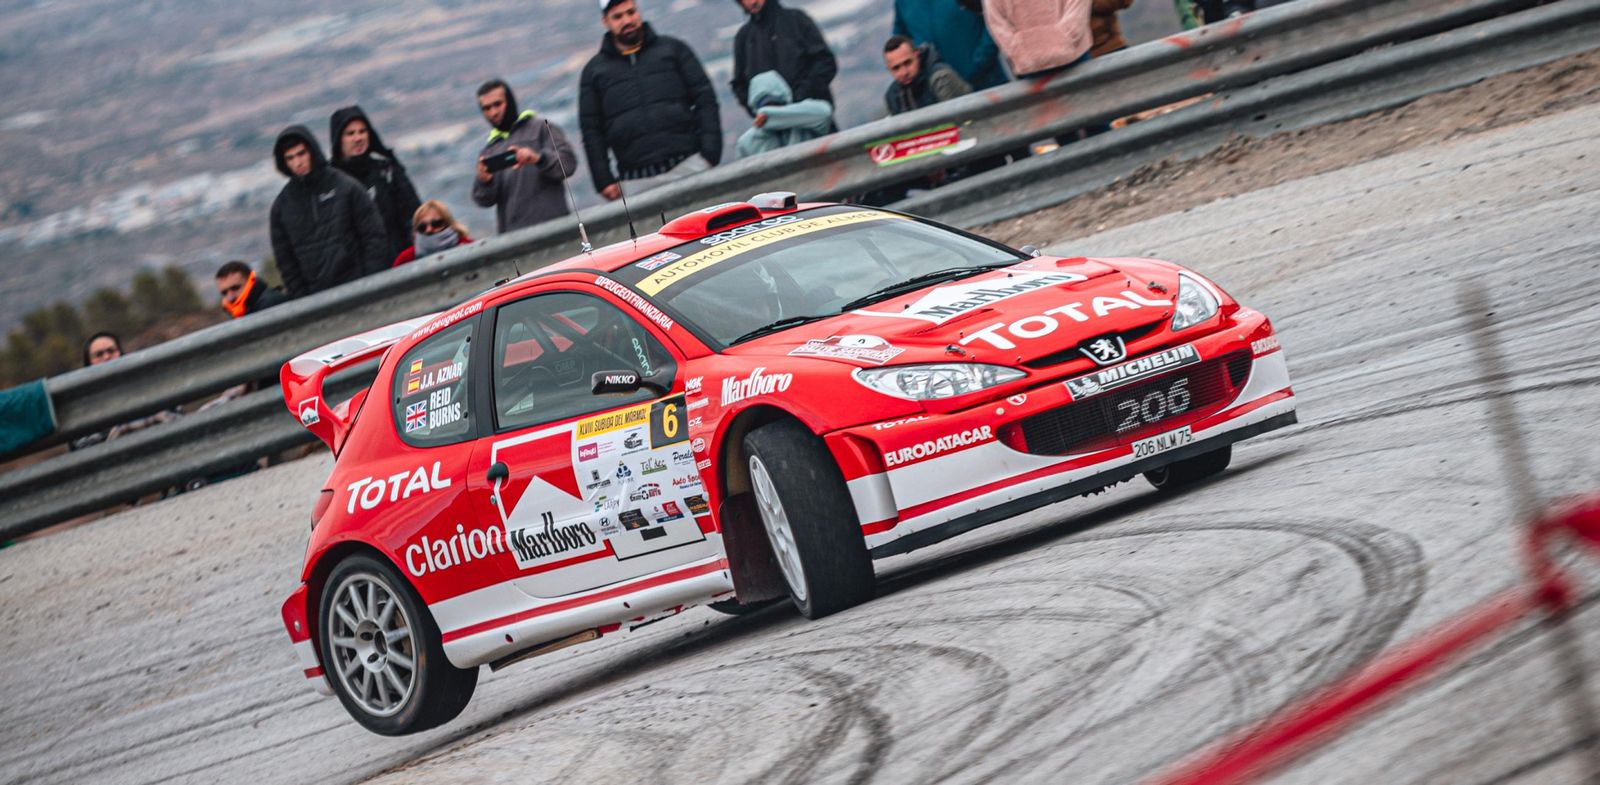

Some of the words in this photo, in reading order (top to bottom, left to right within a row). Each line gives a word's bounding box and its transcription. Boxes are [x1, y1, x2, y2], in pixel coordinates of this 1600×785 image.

[700, 216, 803, 246] sparco
[653, 238, 751, 285] AUTOMOVIL
[751, 227, 796, 242] CLUB
[797, 220, 823, 230] DE
[916, 274, 1074, 319] Marlboro
[412, 301, 483, 340] www.peugeot.com
[958, 291, 1173, 350] TOTAL
[420, 372, 435, 390] J.A.
[437, 362, 463, 384] AZNAR
[632, 338, 653, 376] sparc
[1098, 345, 1194, 385] MICHELIN
[430, 387, 451, 410] REID
[605, 375, 636, 385] NIKKO
[685, 376, 704, 390] NGK
[721, 367, 792, 407] Marlboro
[430, 402, 461, 429] BURNS
[595, 416, 614, 432] SUBIDA
[615, 414, 623, 427] DEL
[663, 403, 678, 438] 6
[688, 417, 702, 427] OZ
[872, 416, 929, 431] TOTAL
[1115, 378, 1190, 432] 206
[884, 425, 994, 467] EURODATACAR
[1134, 441, 1155, 458] 206
[1157, 433, 1178, 452] NLM
[1179, 429, 1192, 445] 75
[347, 461, 451, 514] TOTAL
[405, 523, 508, 577] Clarion
[511, 512, 596, 562] Marlboro
